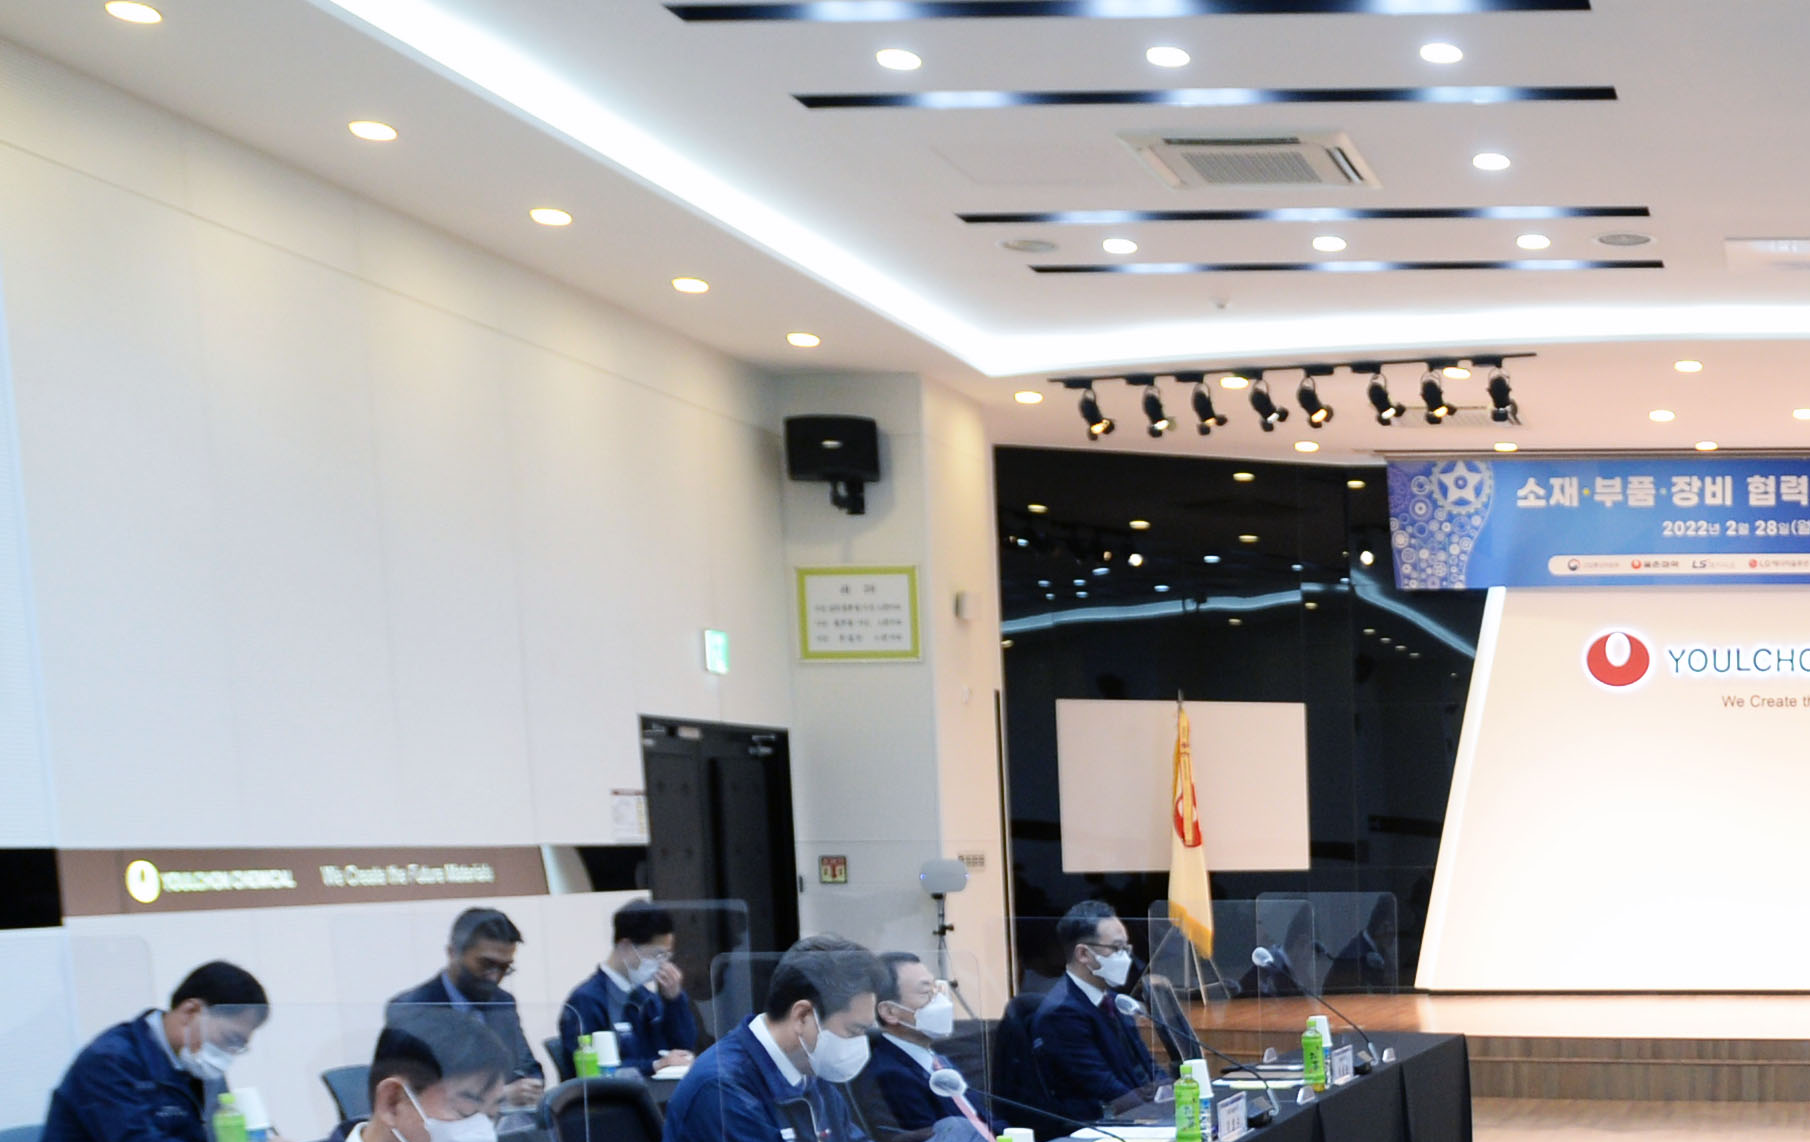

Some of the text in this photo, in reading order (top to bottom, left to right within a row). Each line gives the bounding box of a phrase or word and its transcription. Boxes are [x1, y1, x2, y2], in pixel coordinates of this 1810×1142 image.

[1662, 520, 1720, 537] 2022년
[1725, 520, 1750, 536] 2월
[1721, 694, 1745, 709] We
[1749, 694, 1798, 709] Create
[319, 864, 344, 888] We
[344, 864, 386, 887] Create
[386, 864, 407, 886] the
[407, 863, 444, 885] Future
